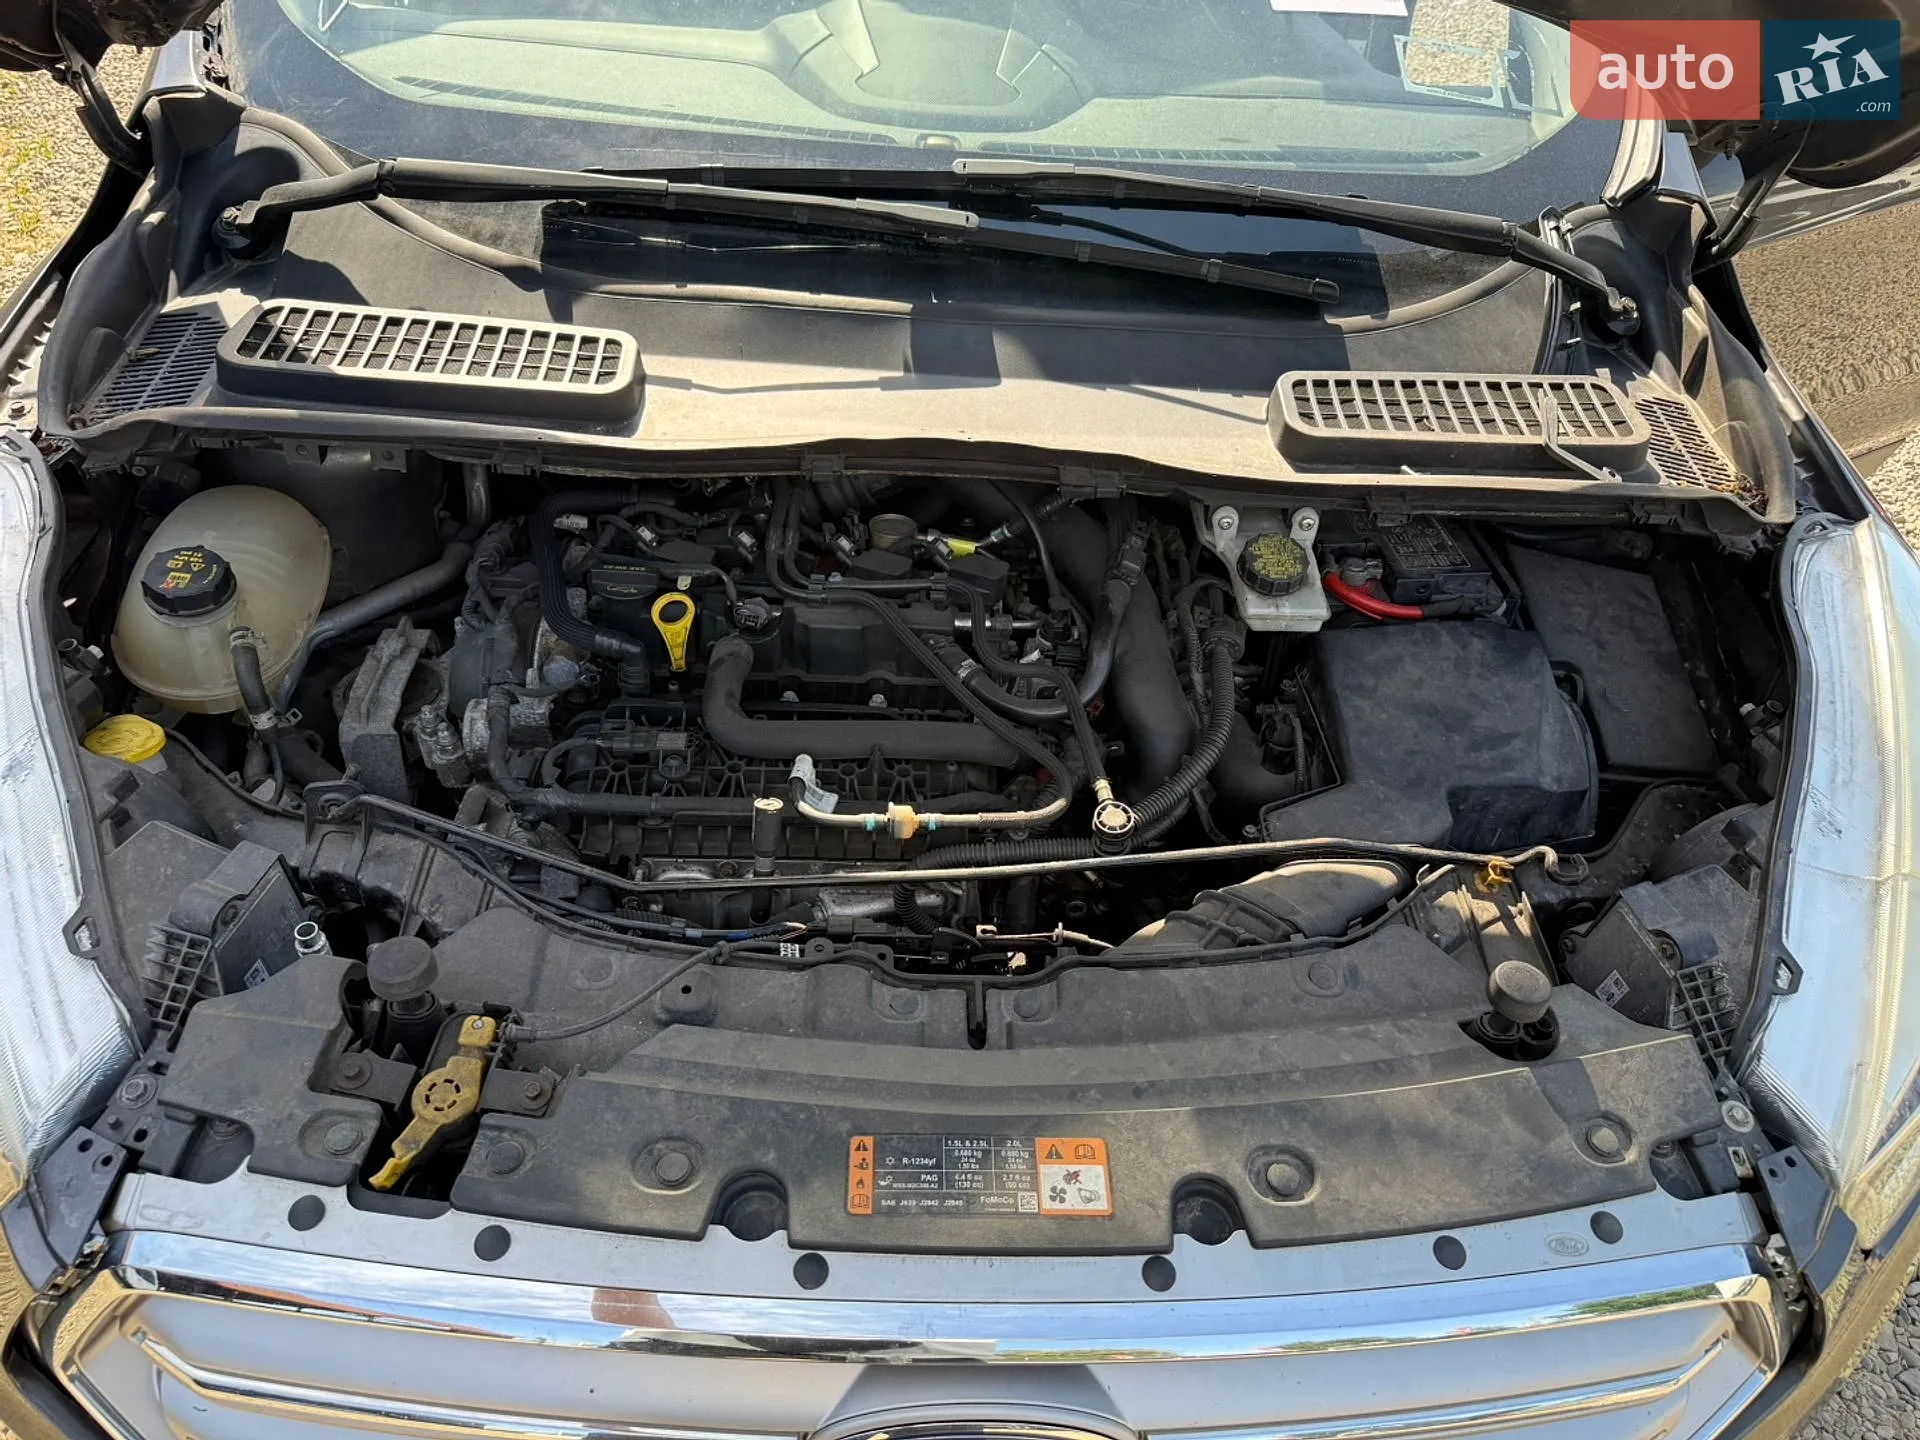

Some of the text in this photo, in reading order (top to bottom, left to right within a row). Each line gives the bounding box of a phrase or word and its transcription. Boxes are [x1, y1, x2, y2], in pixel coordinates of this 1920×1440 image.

[902, 1157, 937, 1166] R-1234yf
[921, 1174, 939, 1182] PAG
[980, 1195, 1014, 1204] FoMoCo
